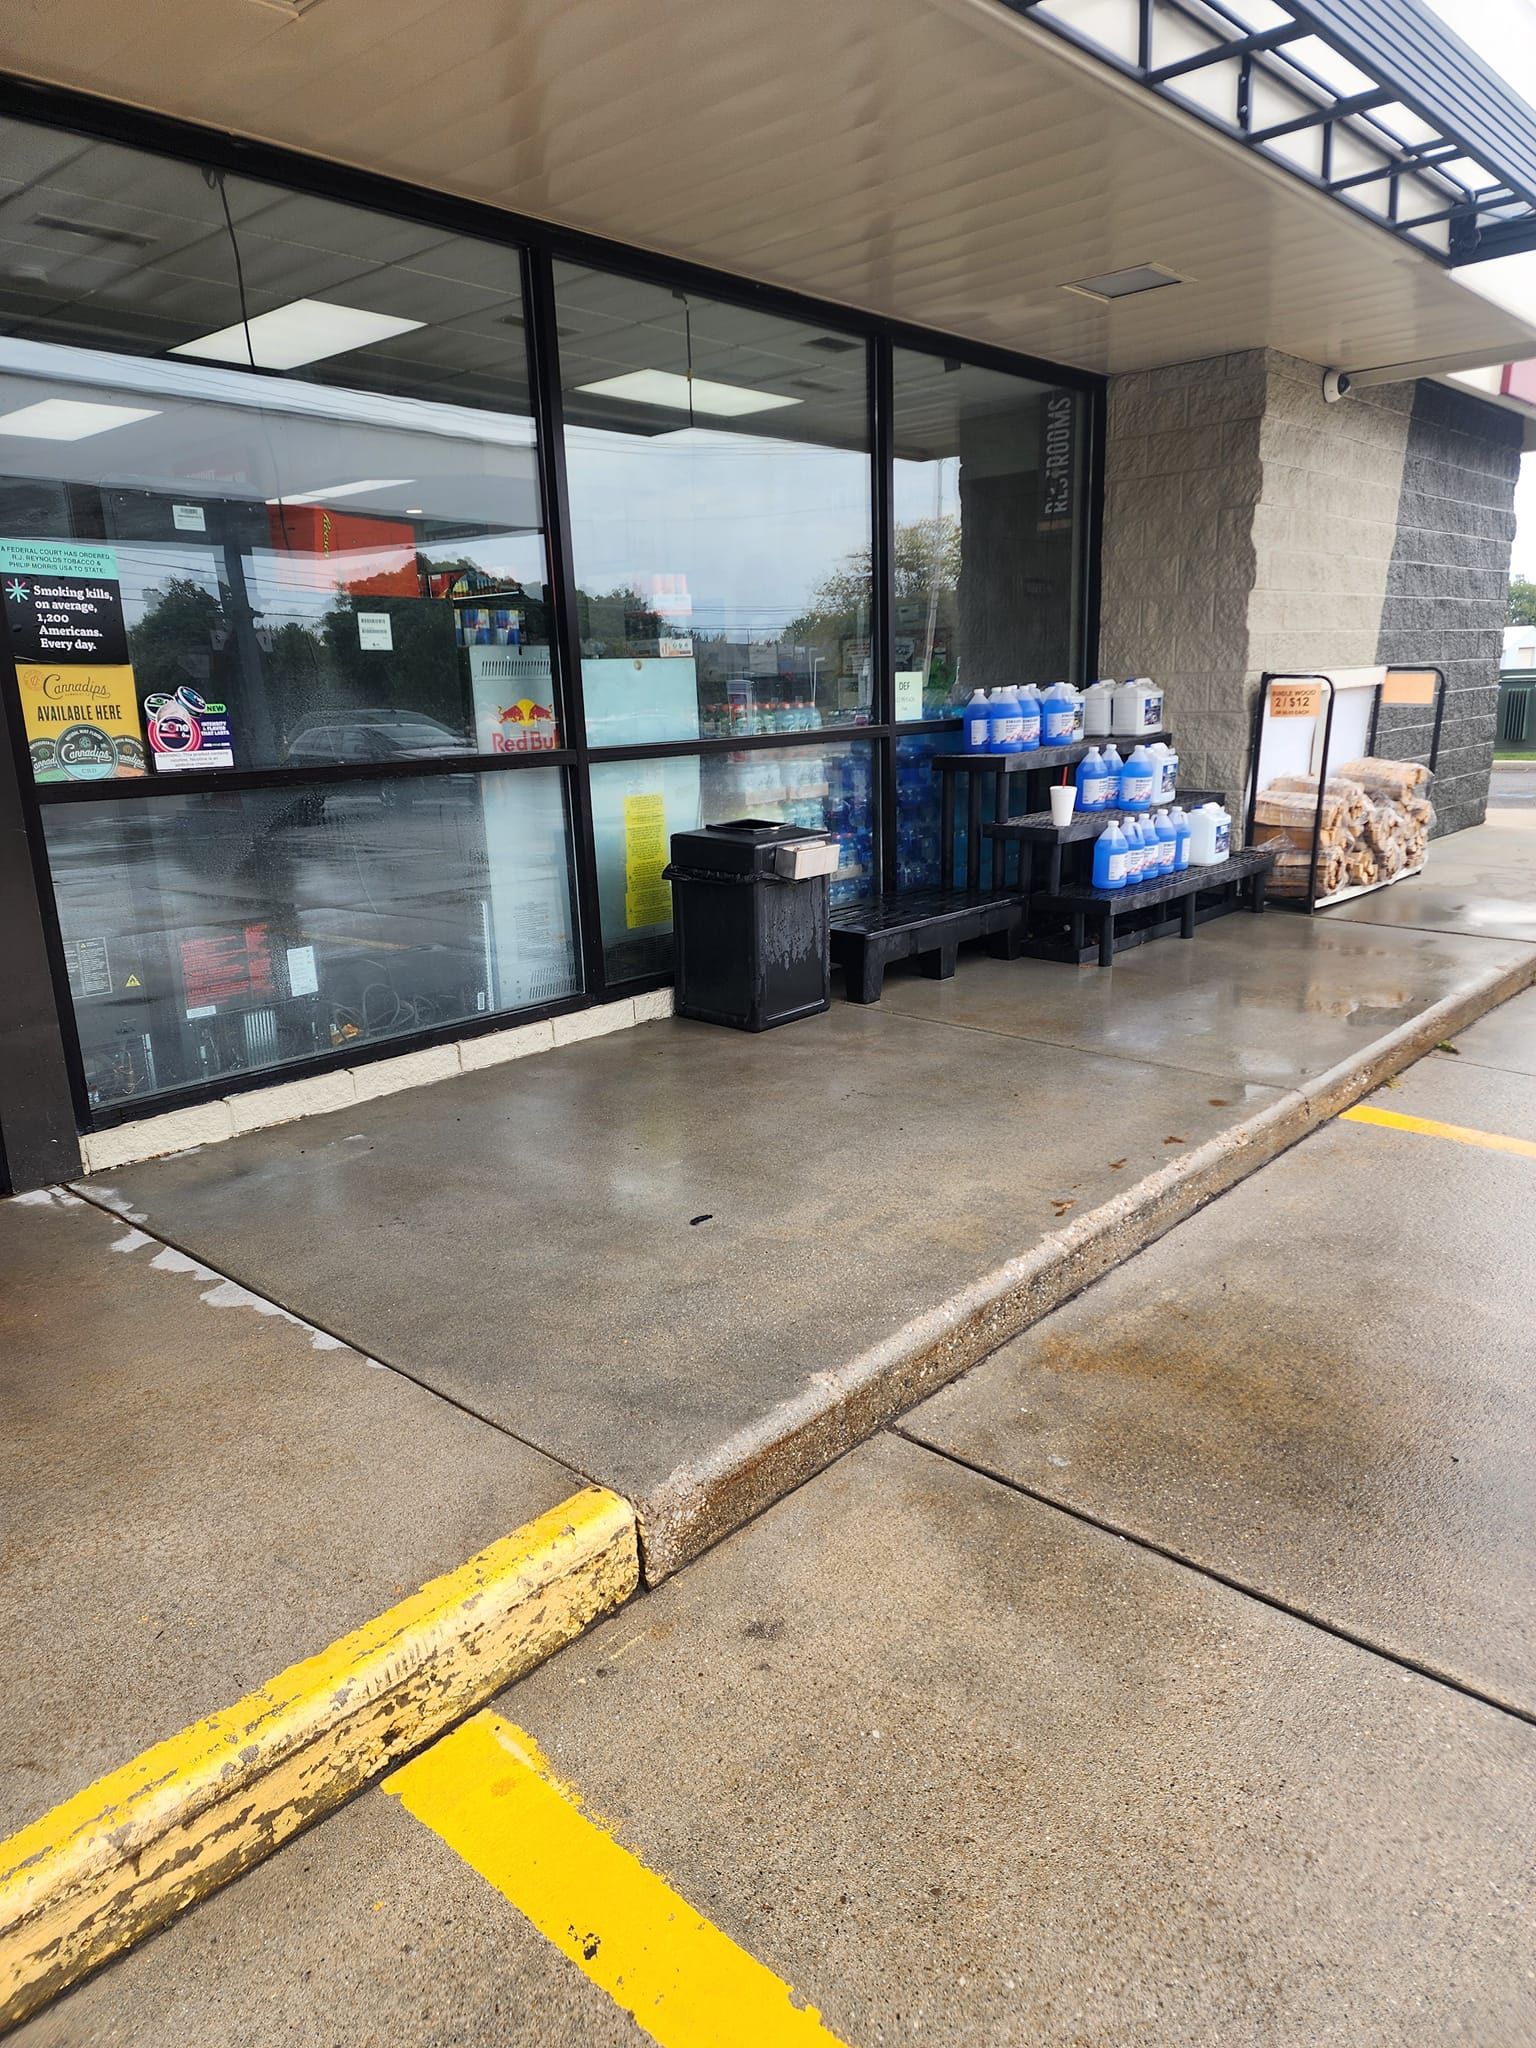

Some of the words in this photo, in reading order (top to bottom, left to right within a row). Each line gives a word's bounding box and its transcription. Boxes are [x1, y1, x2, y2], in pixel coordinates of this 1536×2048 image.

[7, 546, 38, 554] FEDERAL
[39, 548, 62, 556] COURT
[79, 551, 110, 560] ORDERED
[26, 555, 62, 563] REYNOLDS
[64, 558, 95, 566] TOBACCO
[33, 585, 85, 600] Smoking
[85, 588, 113, 601] kills,
[35, 601, 51, 609] on
[52, 602, 98, 613] average,
[37, 614, 70, 624] 1,200
[39, 625, 103, 637] Americans.
[40, 638, 73, 651] Every
[74, 639, 97, 652] day.
[43, 673, 111, 701] Cannadips
[899, 681, 910, 690] DEF
[1275, 698, 1281, 707] 2
[1290, 697, 1310, 708] $12
[37, 705, 94, 721] AVAILABLE
[95, 705, 122, 720] HERE
[491, 730, 528, 752] Red
[530, 728, 559, 751] Bul
[61, 743, 112, 763] Cannadips
